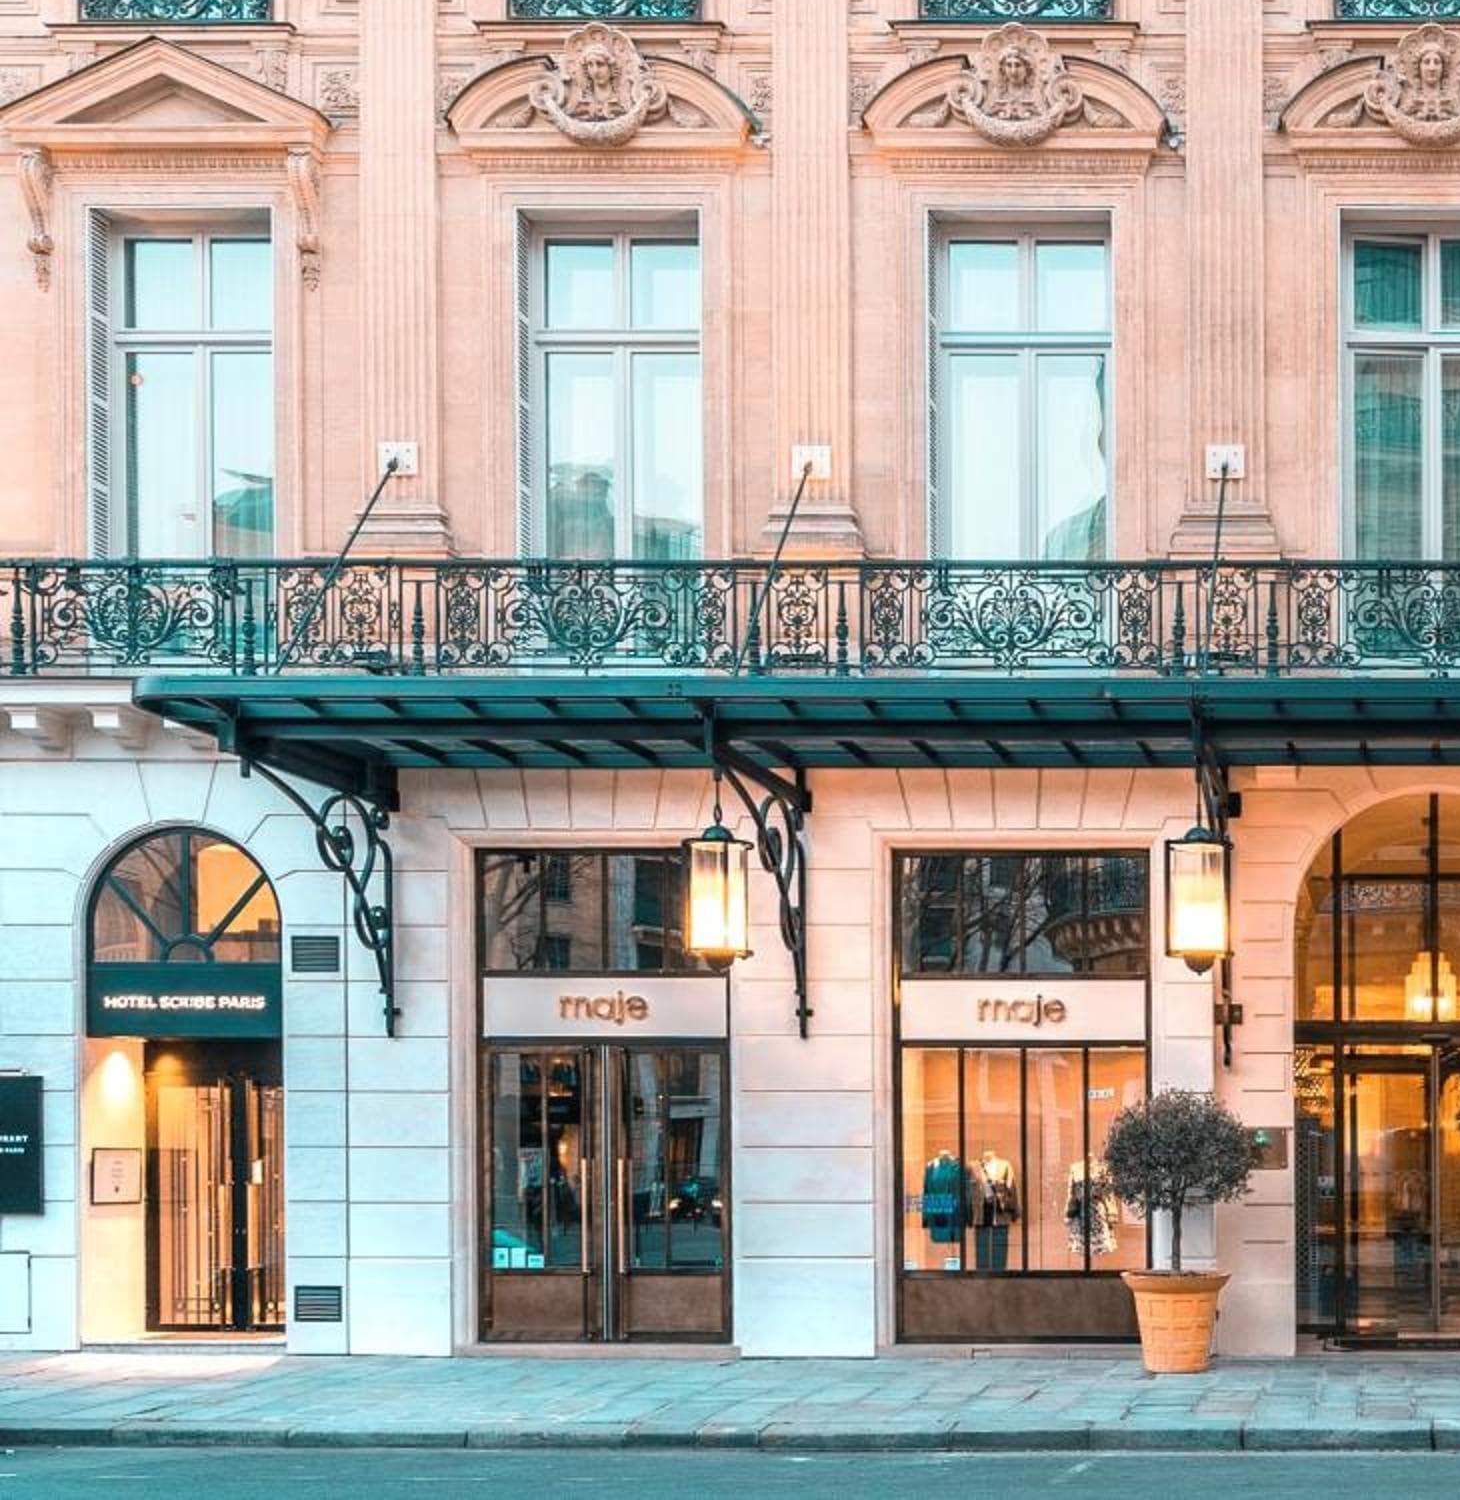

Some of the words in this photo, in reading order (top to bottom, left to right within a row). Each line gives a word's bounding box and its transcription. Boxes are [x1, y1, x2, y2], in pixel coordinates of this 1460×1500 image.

[103, 996, 157, 1009] HOTEL
[159, 996, 215, 1009] SCRIBE
[218, 996, 266, 1009] PARIS
[559, 990, 649, 1026] maje
[977, 994, 1067, 1028] maje
